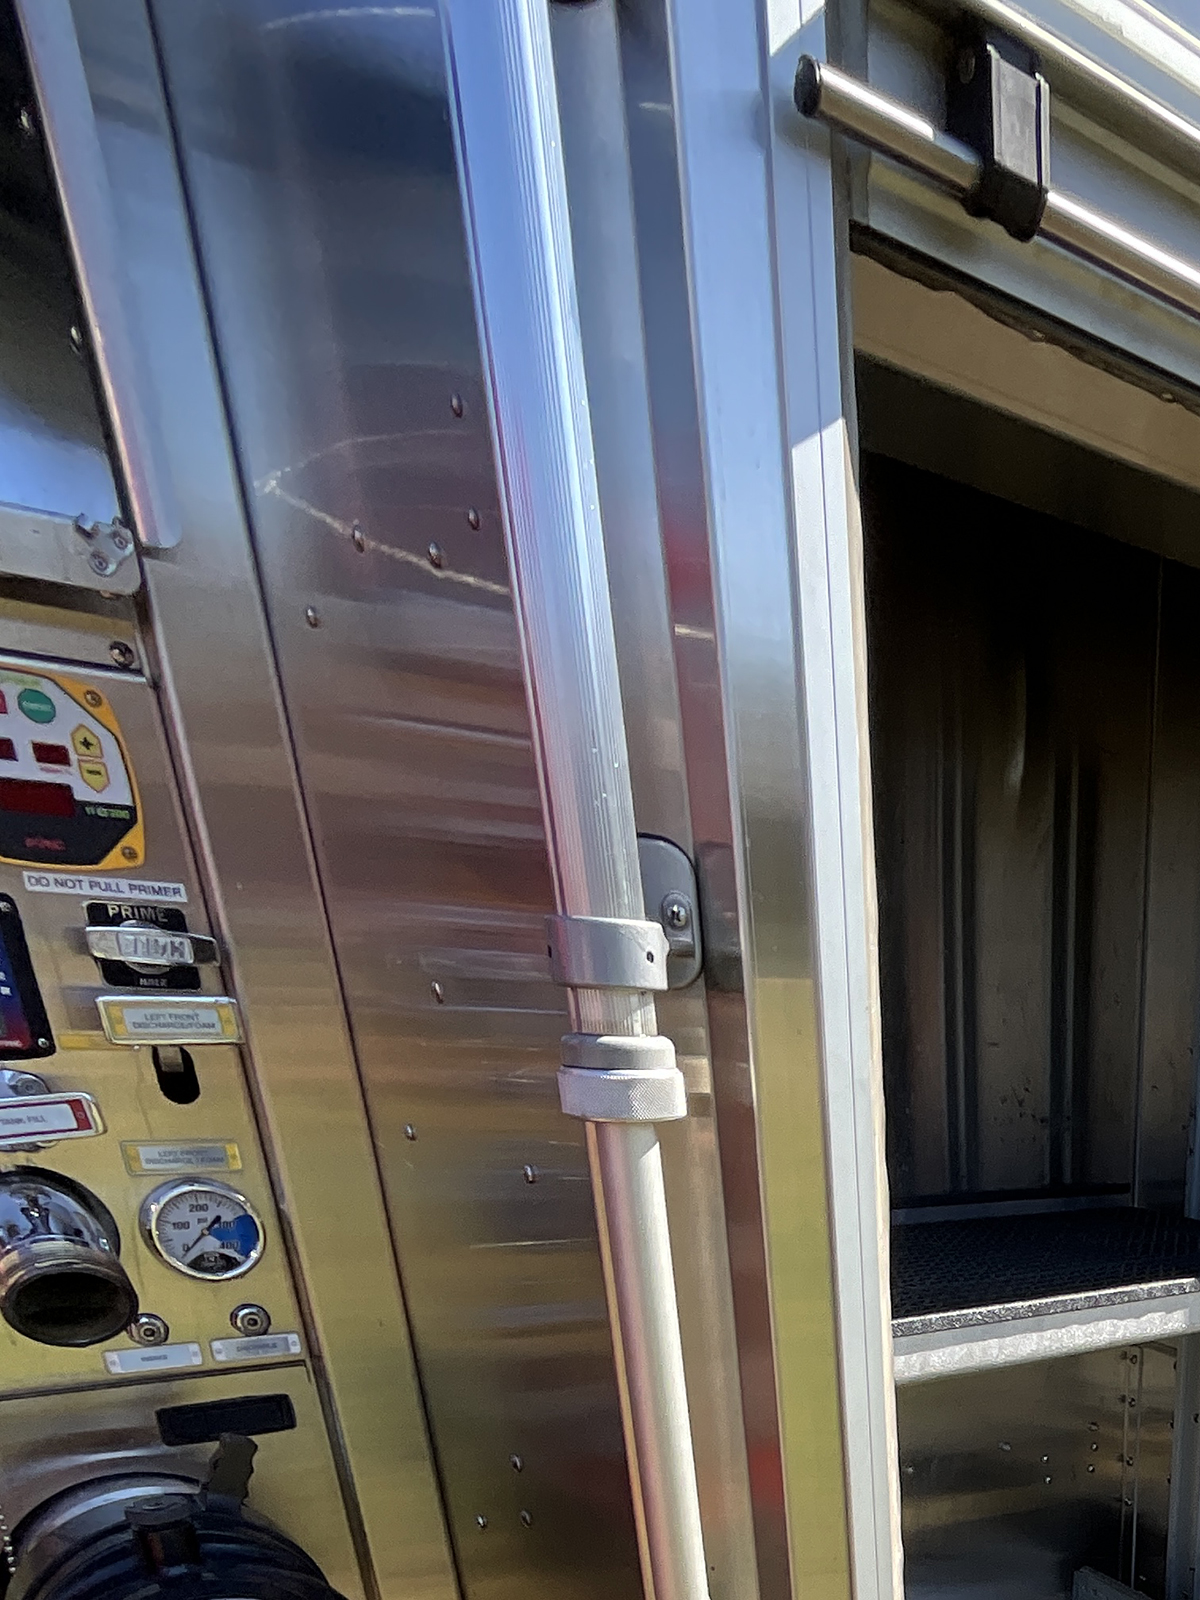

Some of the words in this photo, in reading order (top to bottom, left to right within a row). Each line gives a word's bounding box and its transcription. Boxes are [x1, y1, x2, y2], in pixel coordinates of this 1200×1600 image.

[27, 875, 50, 888] DO
[54, 878, 84, 890] NOT
[89, 880, 125, 894] PULL
[128, 883, 183, 898] PRIMER
[107, 904, 168, 923] PRIME
[188, 1203, 209, 1213] 200
[172, 1221, 191, 1230] 100
[220, 1241, 239, 1250] 400
